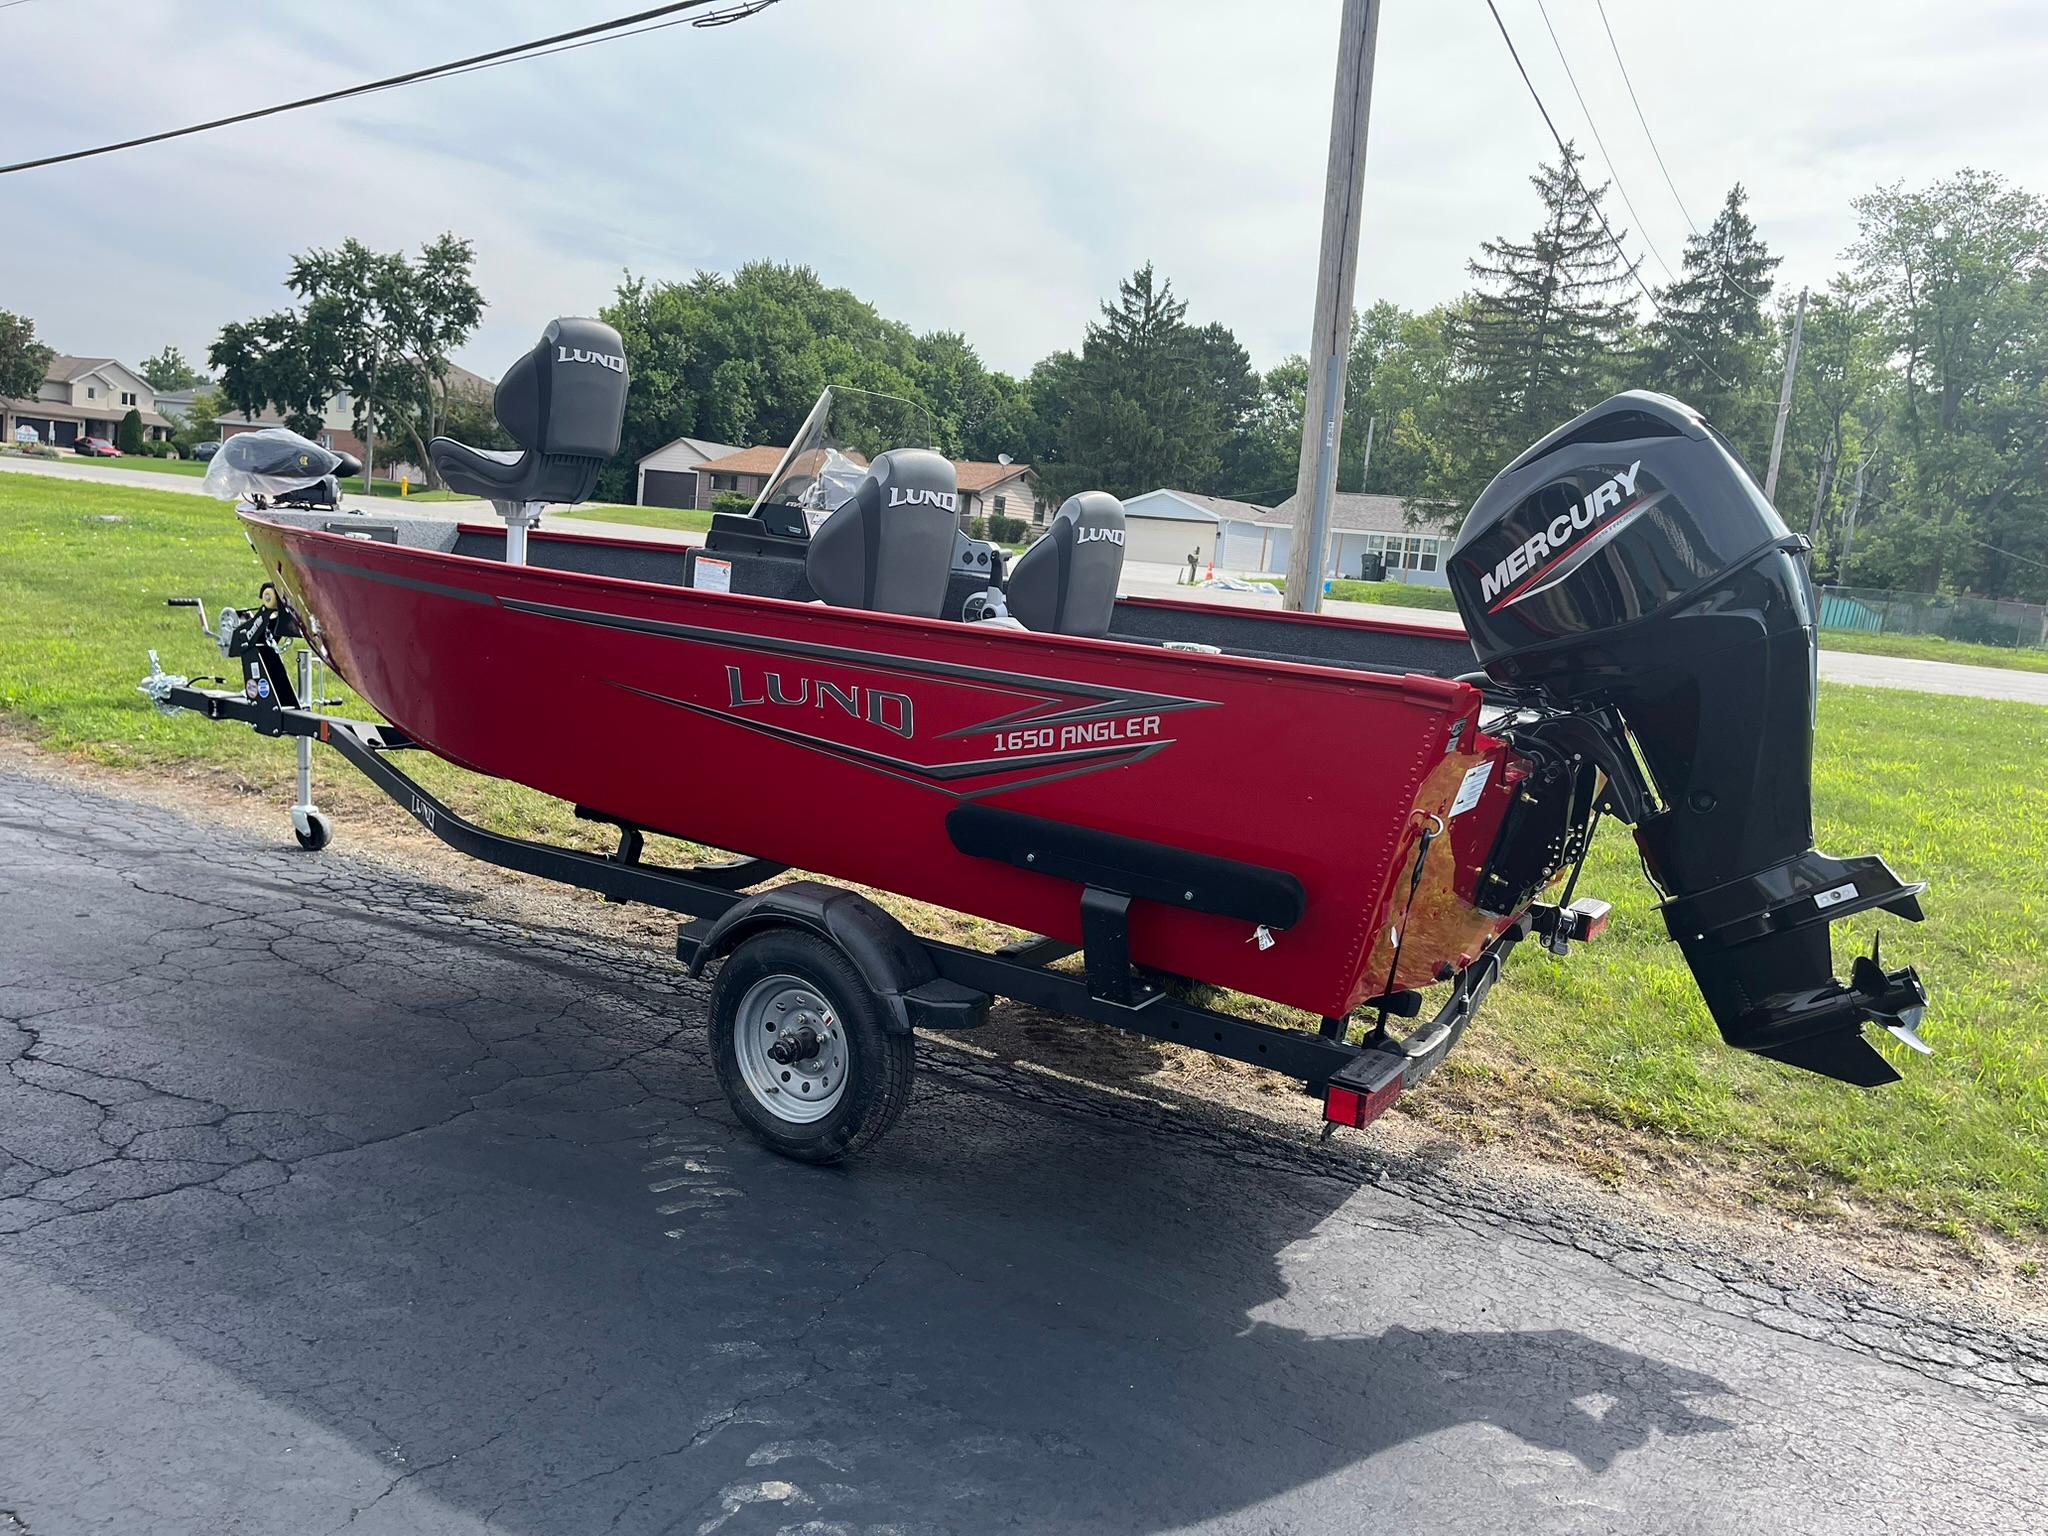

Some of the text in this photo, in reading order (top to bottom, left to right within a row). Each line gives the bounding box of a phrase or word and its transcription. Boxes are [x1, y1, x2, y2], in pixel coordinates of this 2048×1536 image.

[558, 346, 625, 373] LUND
[888, 487, 957, 513] LUND
[1077, 526, 1125, 546] LUND
[1480, 460, 1641, 603] MERCURY
[725, 665, 914, 739] LUND
[993, 715, 1161, 752] 1650 ANGLER
